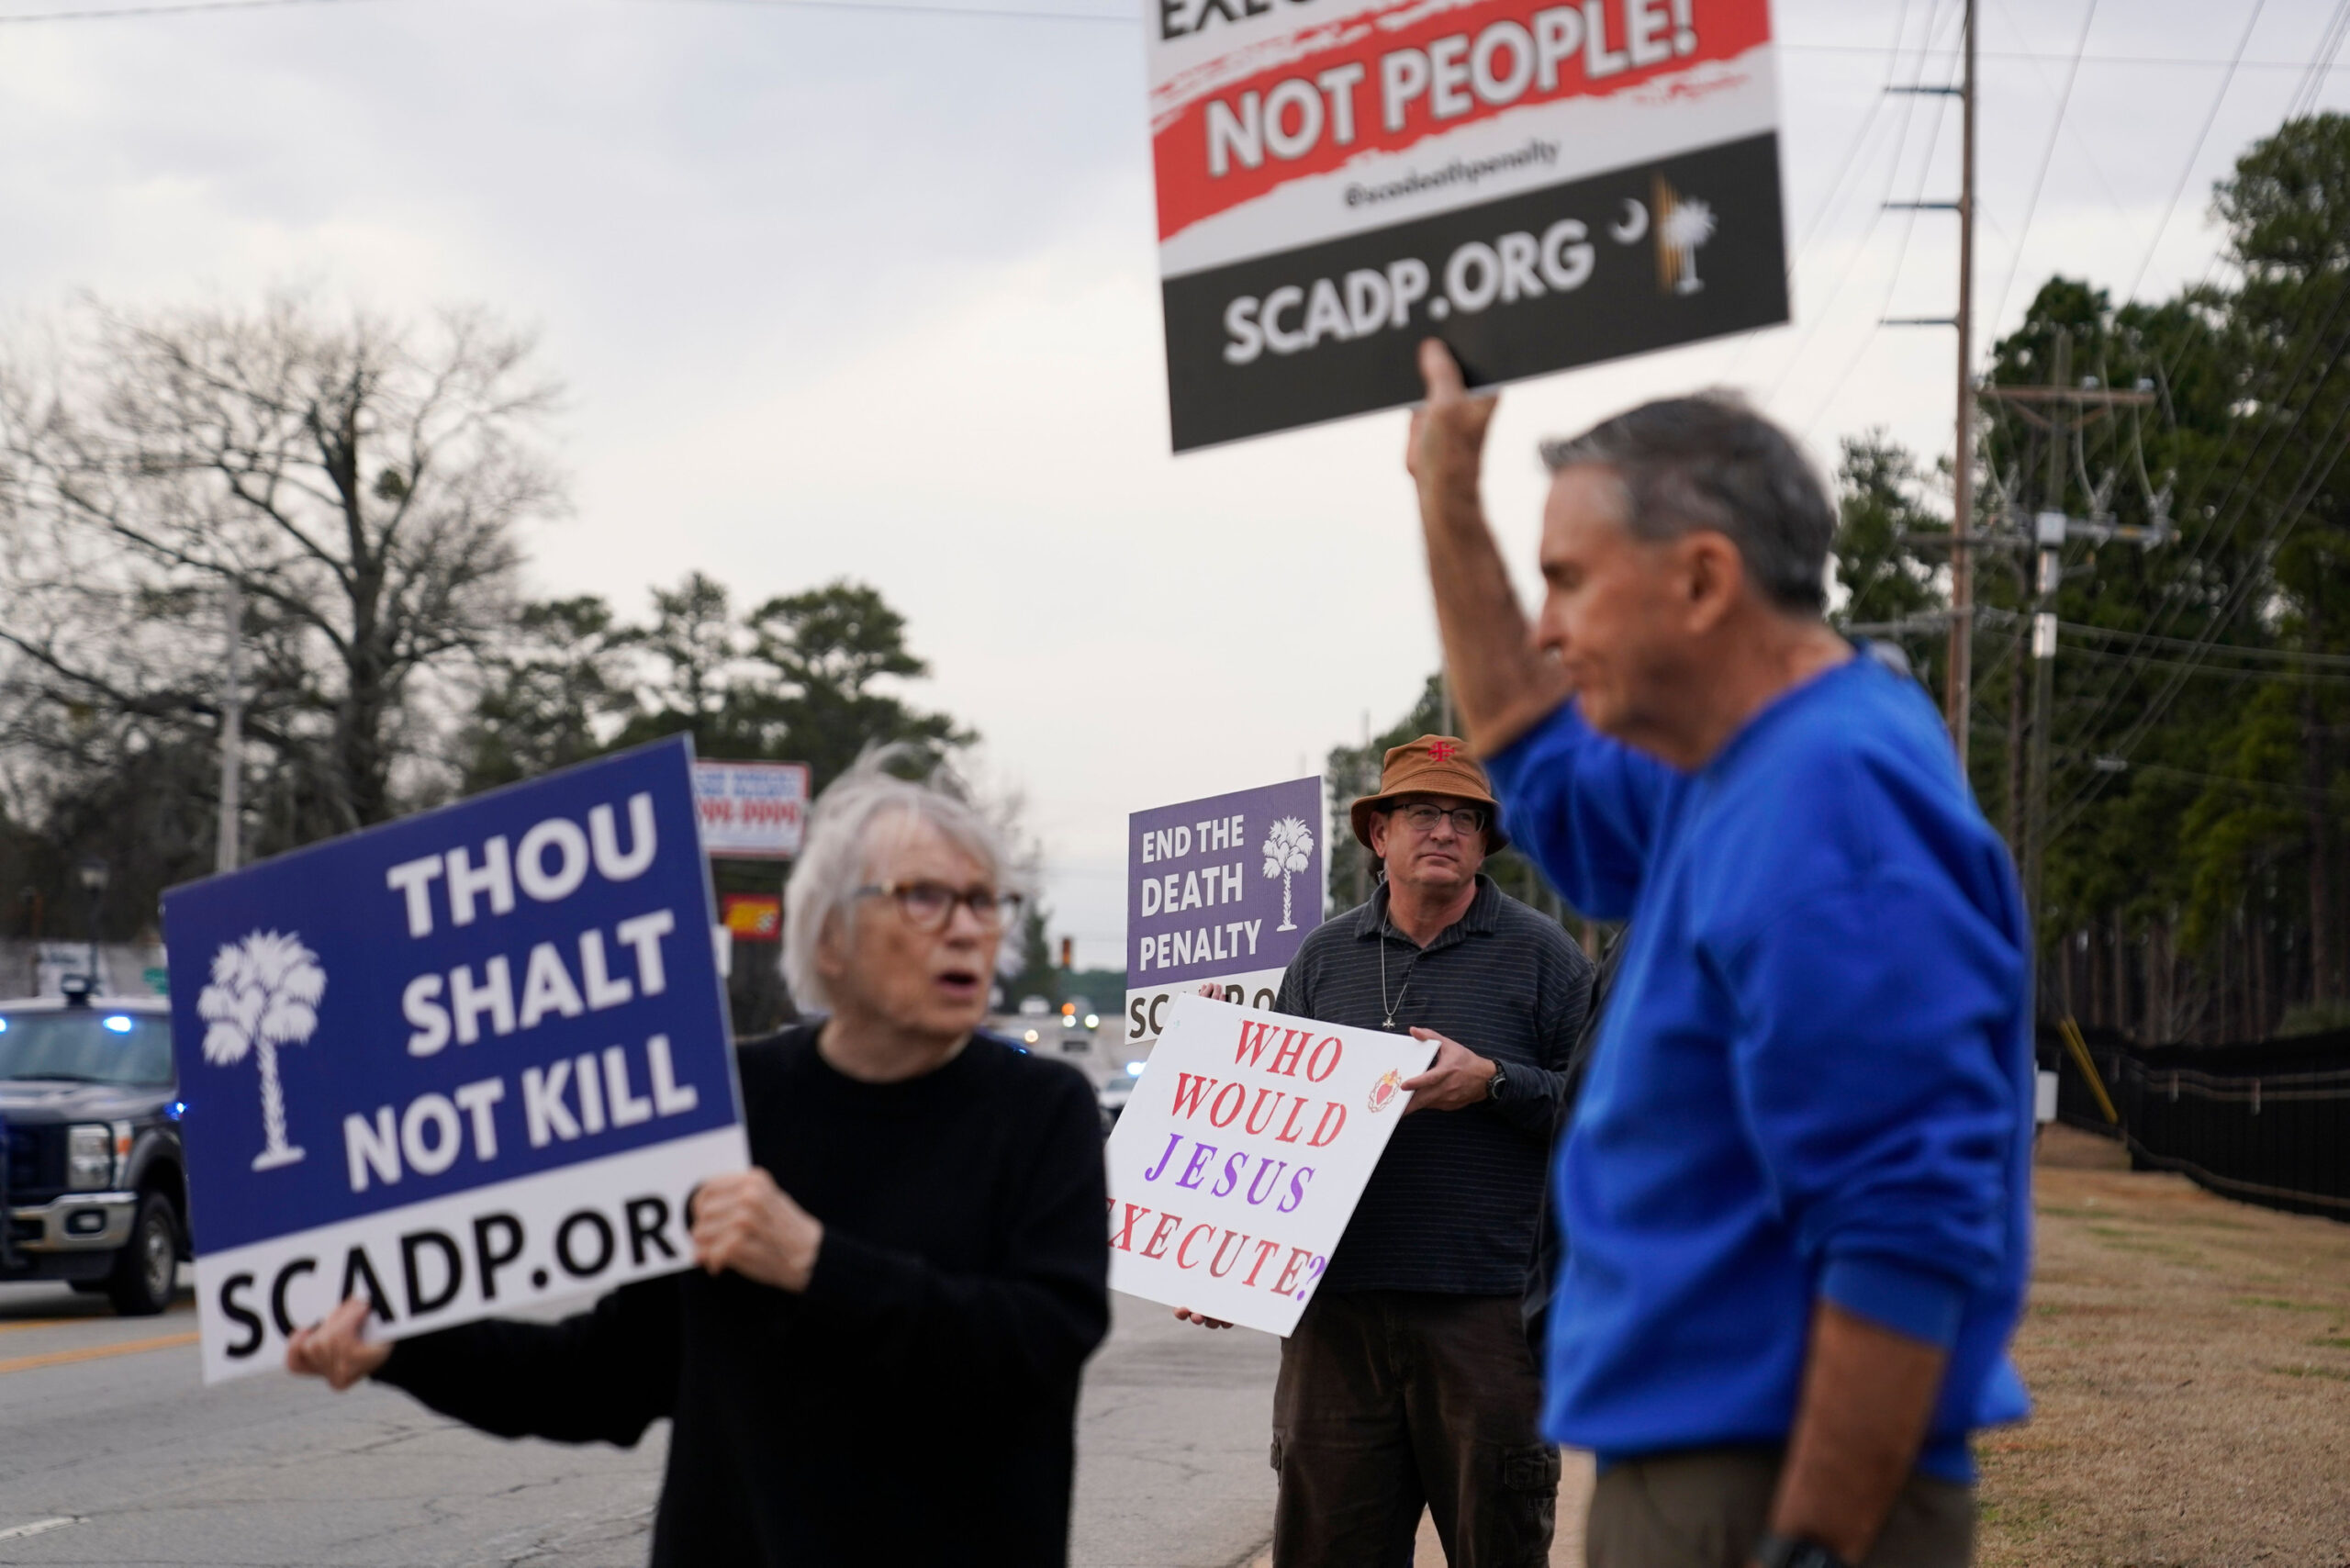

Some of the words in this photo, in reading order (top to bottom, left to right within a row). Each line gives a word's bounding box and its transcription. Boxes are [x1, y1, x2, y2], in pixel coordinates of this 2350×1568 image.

[1207, 63, 1365, 176] NOT
[1383, 0, 1698, 131] PEOPLE!
[1223, 217, 1595, 365] SCADP.ORG
[386, 792, 657, 938] THOU
[1140, 862, 1244, 918] DEATH
[1142, 826, 1192, 863] END
[1196, 815, 1245, 852] THE
[401, 909, 676, 1058] SHALT
[1139, 918, 1263, 972] PENALTY
[1236, 1020, 1343, 1083] WHO
[343, 1077, 505, 1193] NOT
[521, 1033, 699, 1149] KILL
[1172, 1072, 1347, 1147] WOULD
[1144, 1133, 1316, 1214] JESUS
[219, 1183, 699, 1359] SCADP.OR
[1105, 1196, 1327, 1302] XECUTE?
